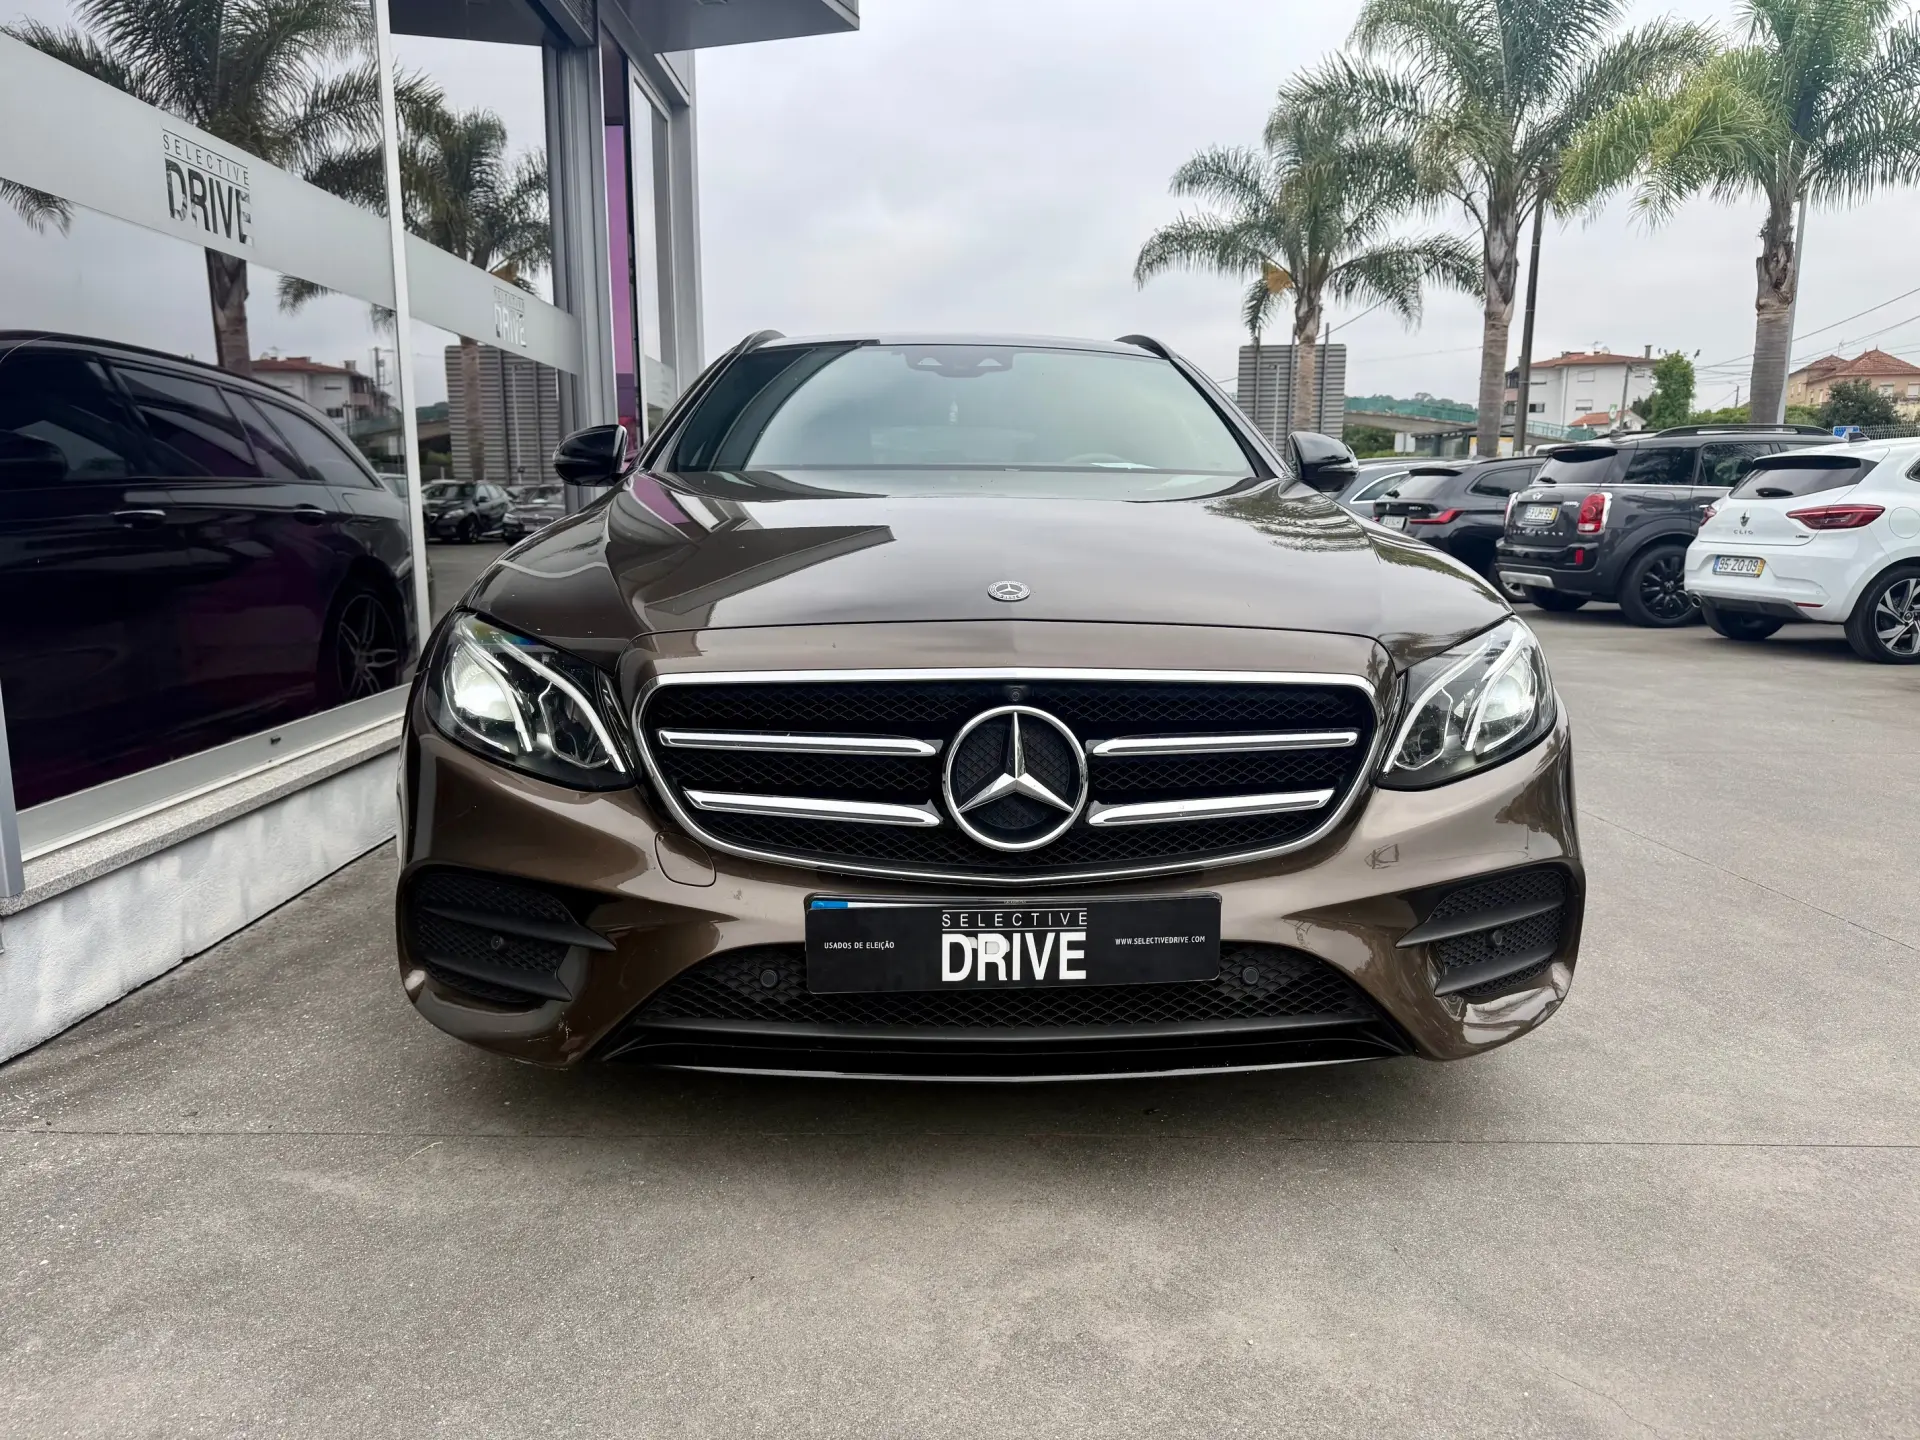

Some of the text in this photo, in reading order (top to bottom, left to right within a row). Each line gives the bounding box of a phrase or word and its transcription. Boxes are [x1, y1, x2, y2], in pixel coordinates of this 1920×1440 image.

[162, 133, 250, 186] SELECTIVE
[164, 157, 254, 246] DRIVE
[941, 911, 1088, 927] SELECTIVE
[824, 940, 895, 951] USADOS DE ELEIÇÃO
[941, 931, 1087, 982] DRIVE
[1114, 935, 1206, 946] WWW.SELECTIVEDRIVE.COM
